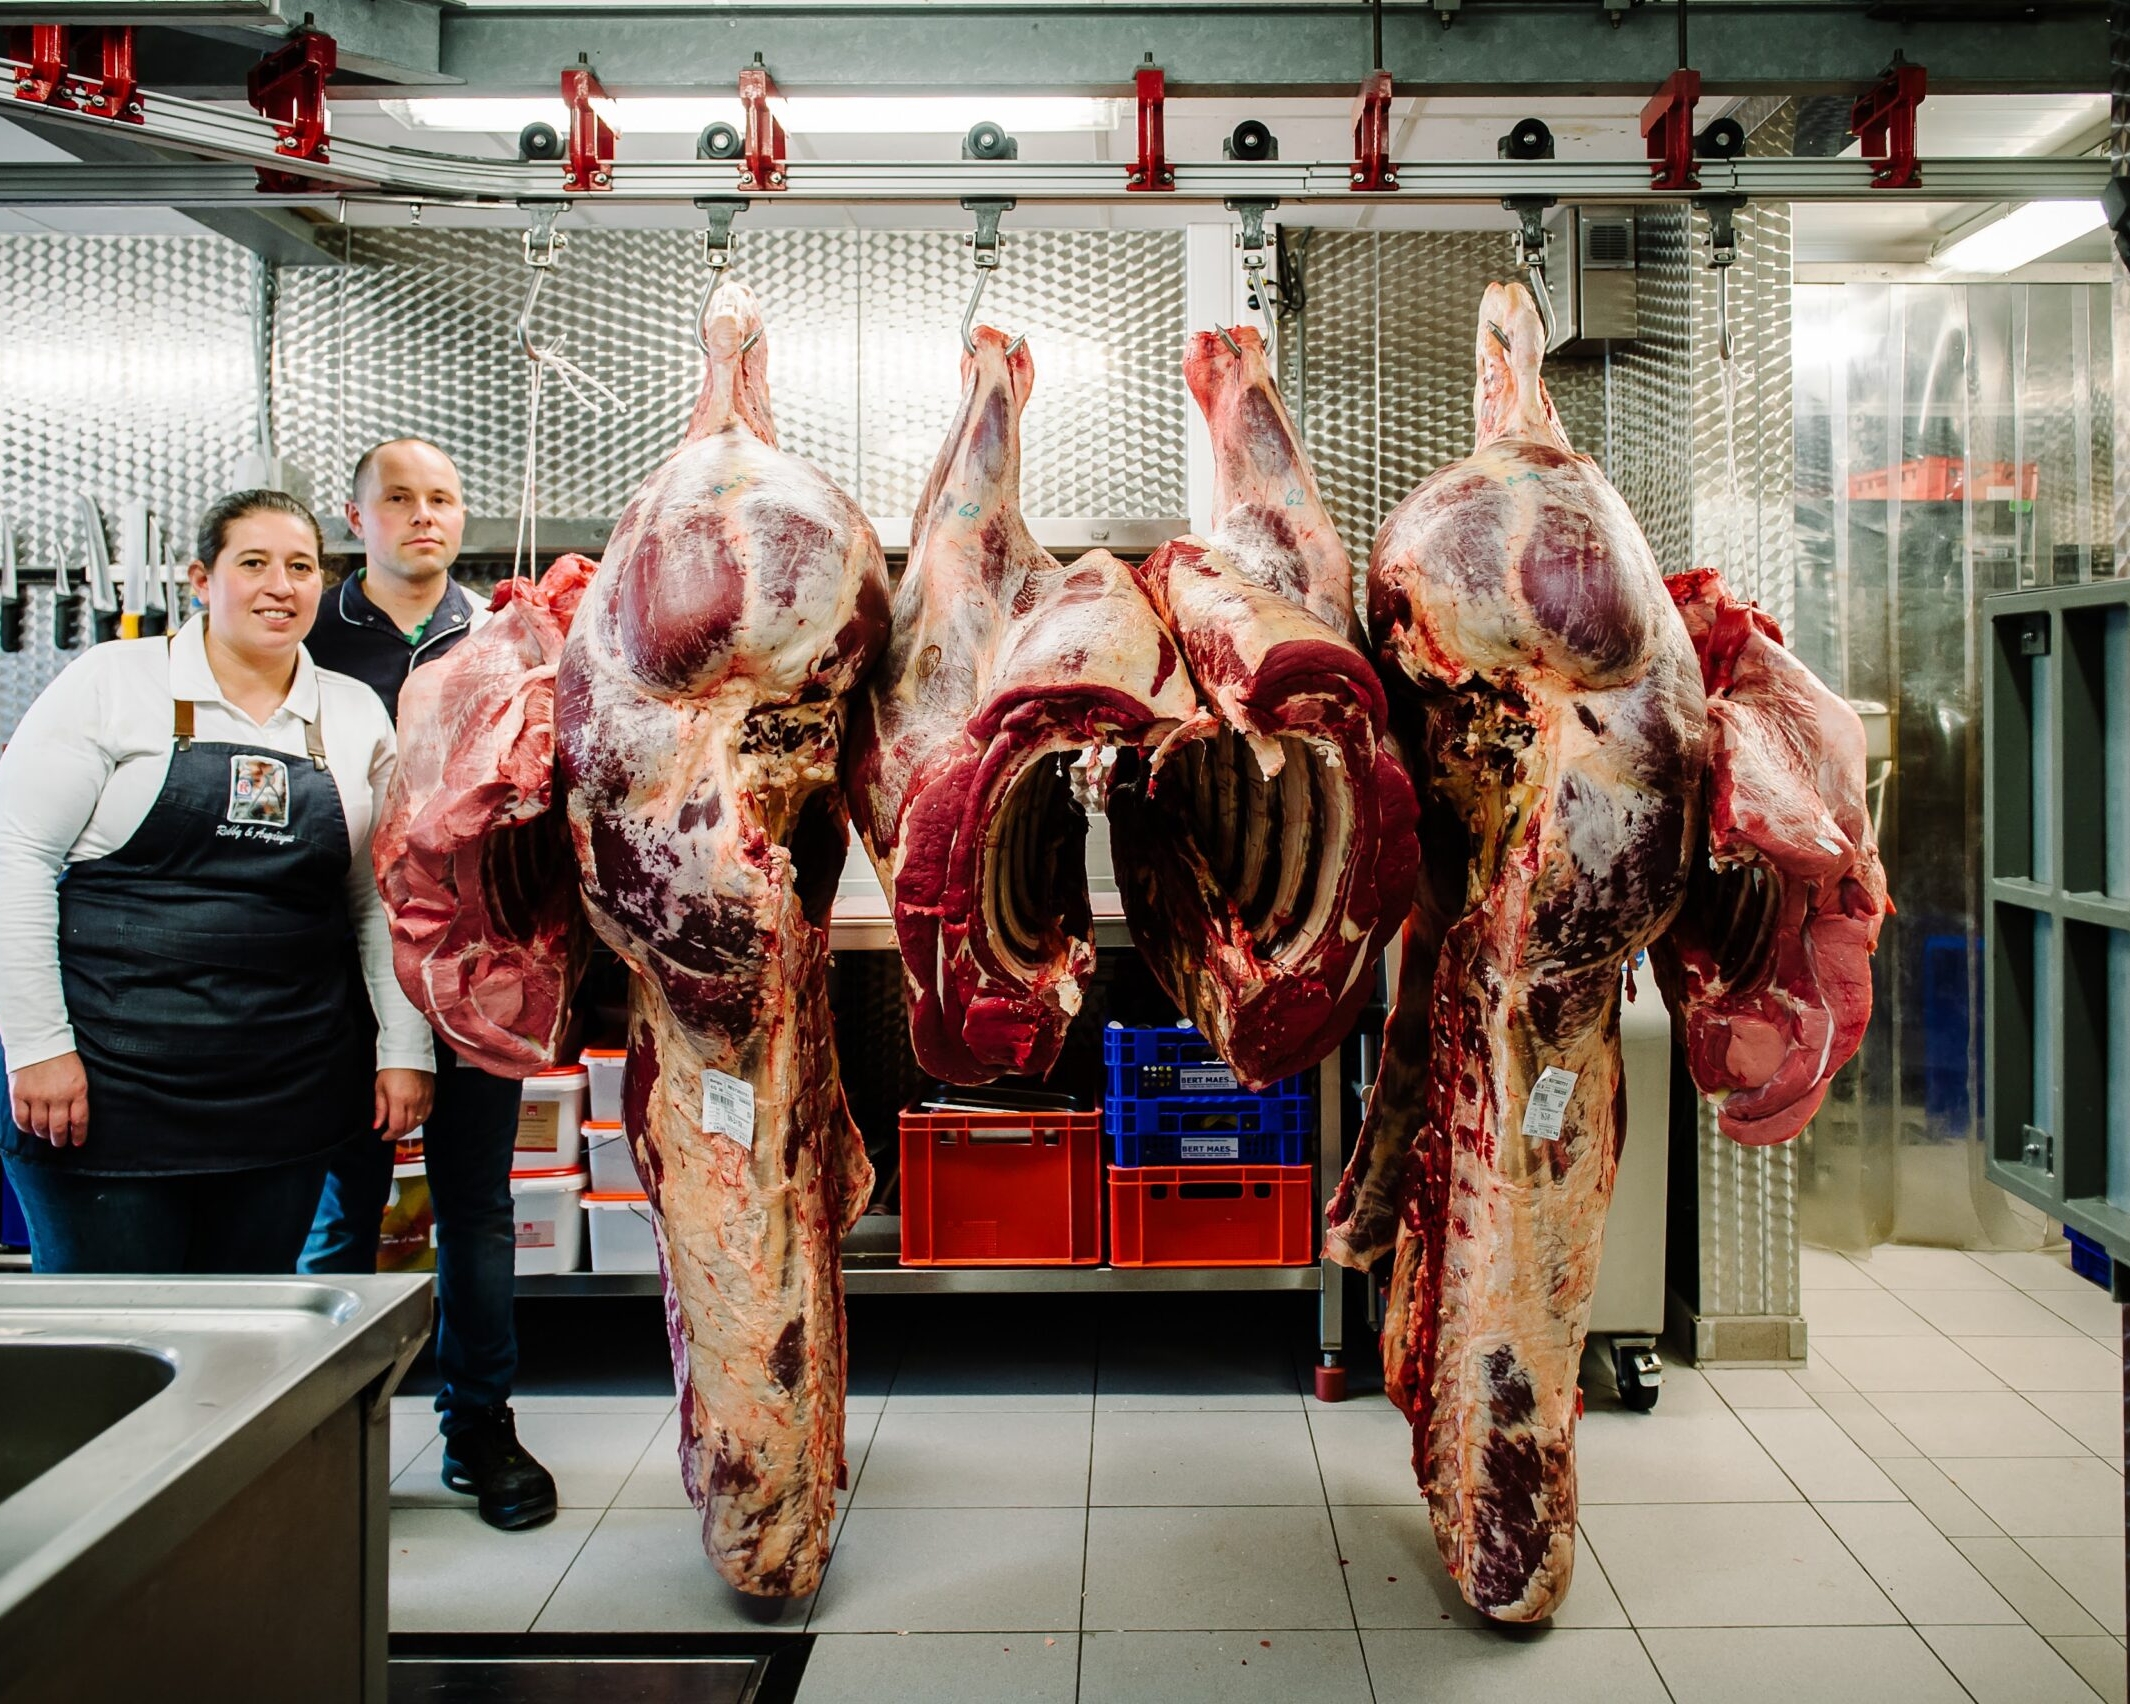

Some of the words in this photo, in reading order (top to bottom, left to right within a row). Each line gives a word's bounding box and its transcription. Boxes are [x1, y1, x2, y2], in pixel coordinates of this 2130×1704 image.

[1286, 489, 1304, 506] 62
[958, 502, 980, 520] 62
[244, 826, 254, 837] &
[1181, 1076, 1204, 1084] BERT
[1182, 1145, 1204, 1153] BERT
[1206, 1145, 1231, 1153] MAES
